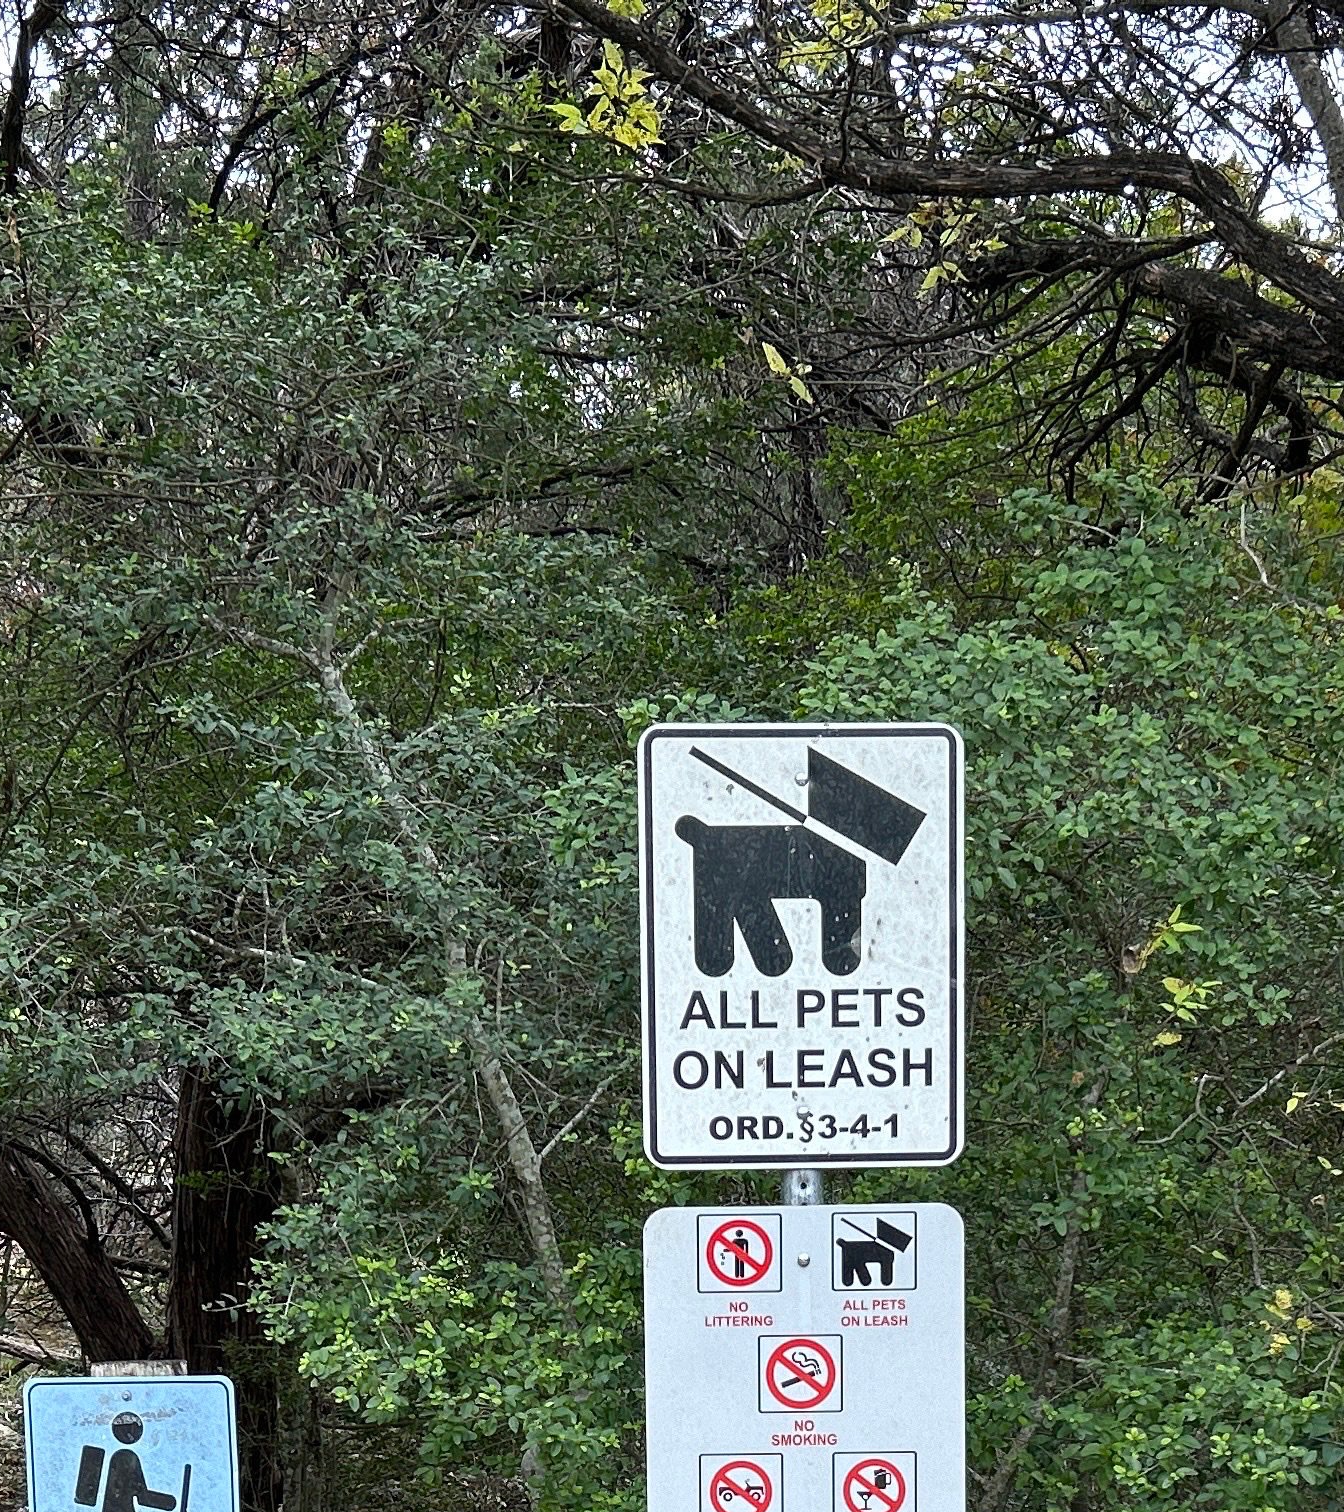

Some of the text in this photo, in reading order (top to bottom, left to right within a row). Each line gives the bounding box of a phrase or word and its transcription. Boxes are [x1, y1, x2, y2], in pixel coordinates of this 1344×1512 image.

[680, 988, 925, 1029] ALL PETS
[673, 1048, 932, 1089] ON LEASH
[730, 1302, 748, 1312] NO
[843, 1300, 905, 1310] ALL PETS
[705, 1316, 773, 1326] LITTERING
[841, 1316, 907, 1326] ON LEASH
[795, 1420, 814, 1431] NO
[772, 1434, 837, 1446] SMOKING
